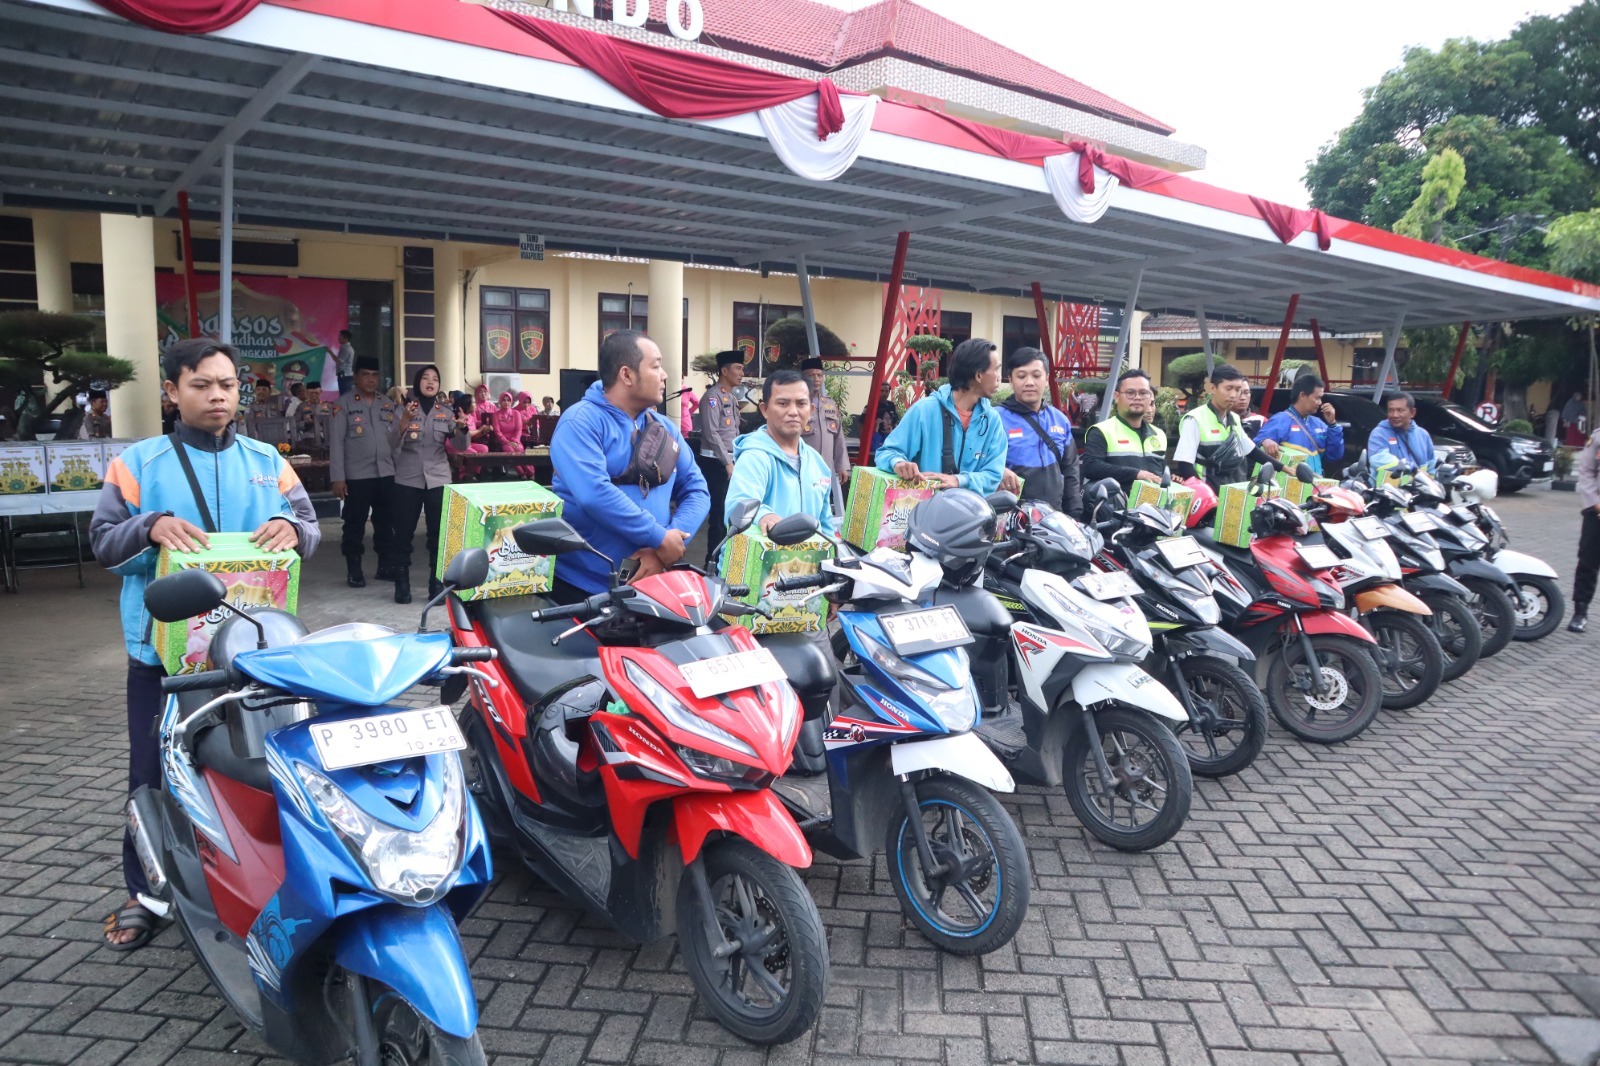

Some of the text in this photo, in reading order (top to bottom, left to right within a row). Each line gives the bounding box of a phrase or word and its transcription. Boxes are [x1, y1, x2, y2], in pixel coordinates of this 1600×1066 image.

[520, 242, 544, 253] KAPOLRES
[920, 532, 940, 547] HONDA
[1156, 603, 1180, 621] HONDA
[887, 621, 896, 634] P
[904, 615, 937, 632] 3718
[1021, 628, 1048, 646] HONDA
[682, 666, 693, 681] P
[879, 697, 911, 722] HONDA
[321, 710, 450, 748] P 3980 ET
[628, 725, 666, 757] HONDA
